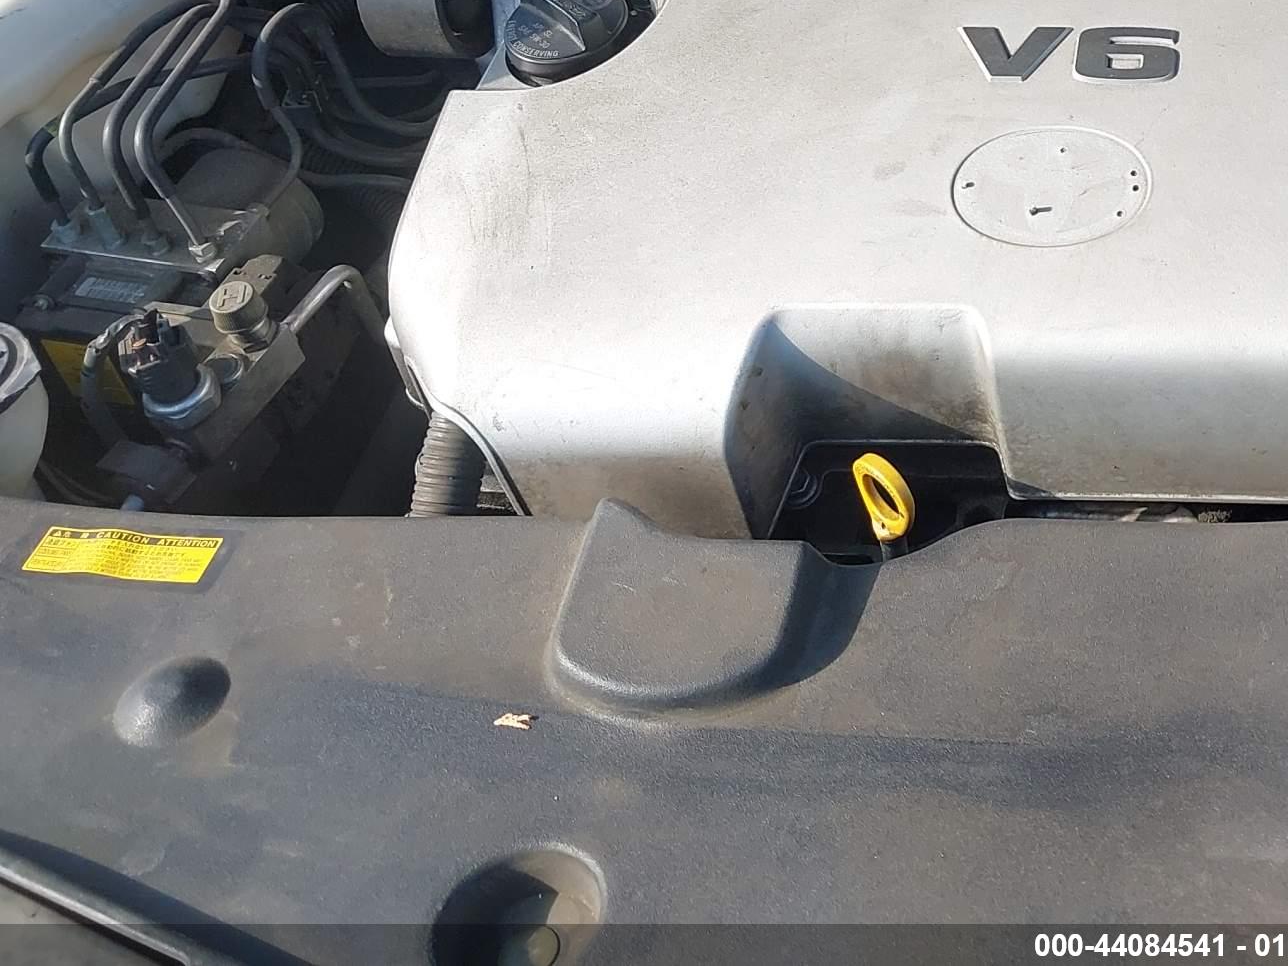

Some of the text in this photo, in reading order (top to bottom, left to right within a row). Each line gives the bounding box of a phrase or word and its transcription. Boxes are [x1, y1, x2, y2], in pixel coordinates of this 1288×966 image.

[512, 40, 559, 58] CONSERVING
[957, 26, 1182, 83] V6
[95, 530, 151, 545] CAUTION
[156, 537, 217, 549] ATTENTION
